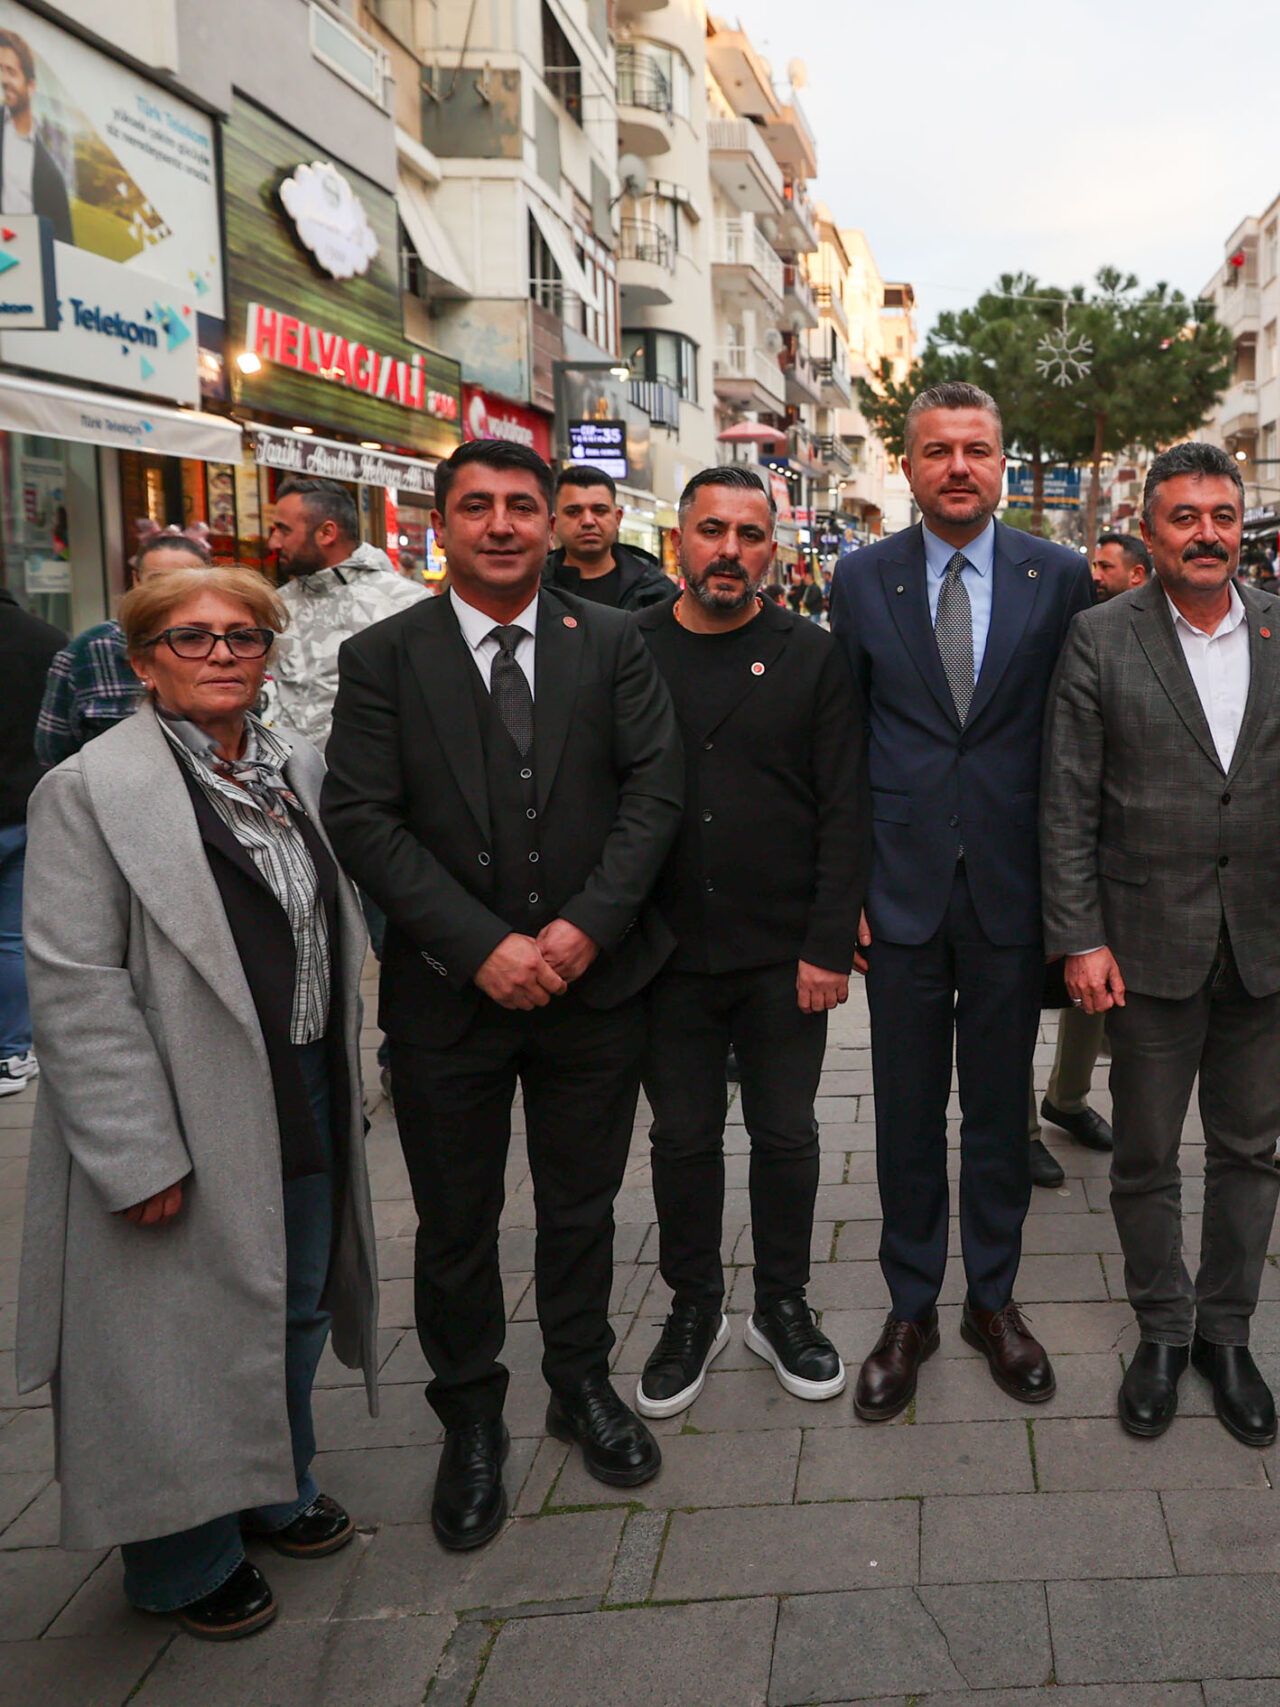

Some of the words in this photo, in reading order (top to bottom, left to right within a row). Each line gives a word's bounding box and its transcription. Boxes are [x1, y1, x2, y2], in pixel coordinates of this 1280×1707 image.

[69, 298, 157, 348] Telekom
[246, 302, 381, 396] HELVACI
[602, 428, 621, 443] 35
